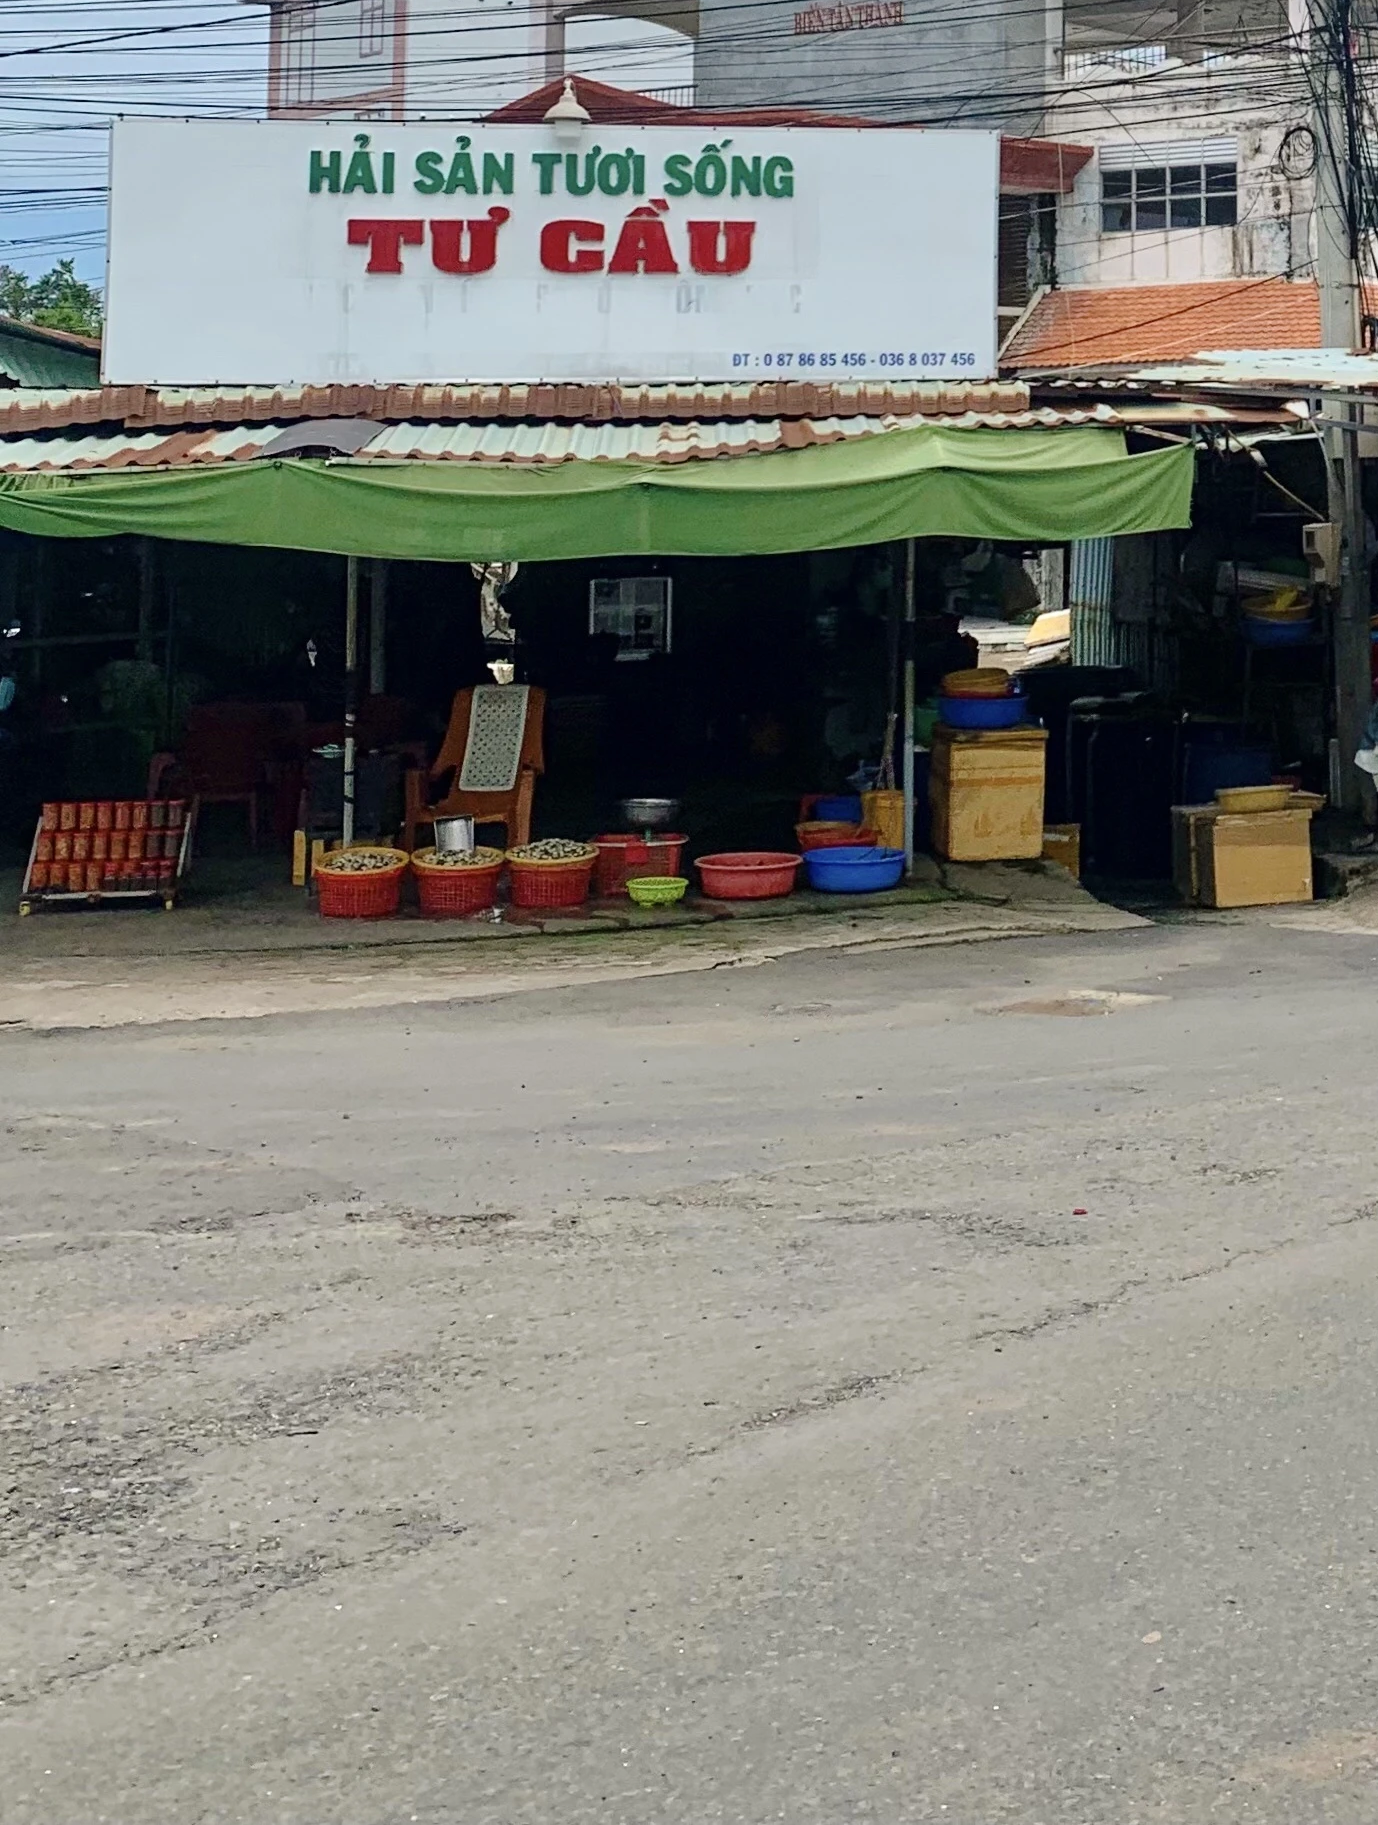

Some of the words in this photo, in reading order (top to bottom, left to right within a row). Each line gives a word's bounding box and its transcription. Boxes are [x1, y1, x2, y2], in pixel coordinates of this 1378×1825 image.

[309, 134, 395, 194] HẢI
[414, 135, 514, 195] SẢN
[532, 146, 646, 196] TƯƠI
[663, 139, 795, 197] SỐNG
[347, 206, 511, 274] TƯ
[539, 197, 757, 275] CẦU
[732, 352, 750, 367] ĐT
[763, 352, 773, 367] 0
[777, 352, 793, 367] 87
[798, 352, 815, 367] 86
[820, 352, 837, 367] 85
[841, 352, 866, 367] 456
[879, 352, 905, 367] 036
[909, 352, 918, 367] 8
[921, 352, 946, 367] 037
[951, 352, 976, 367] 456
